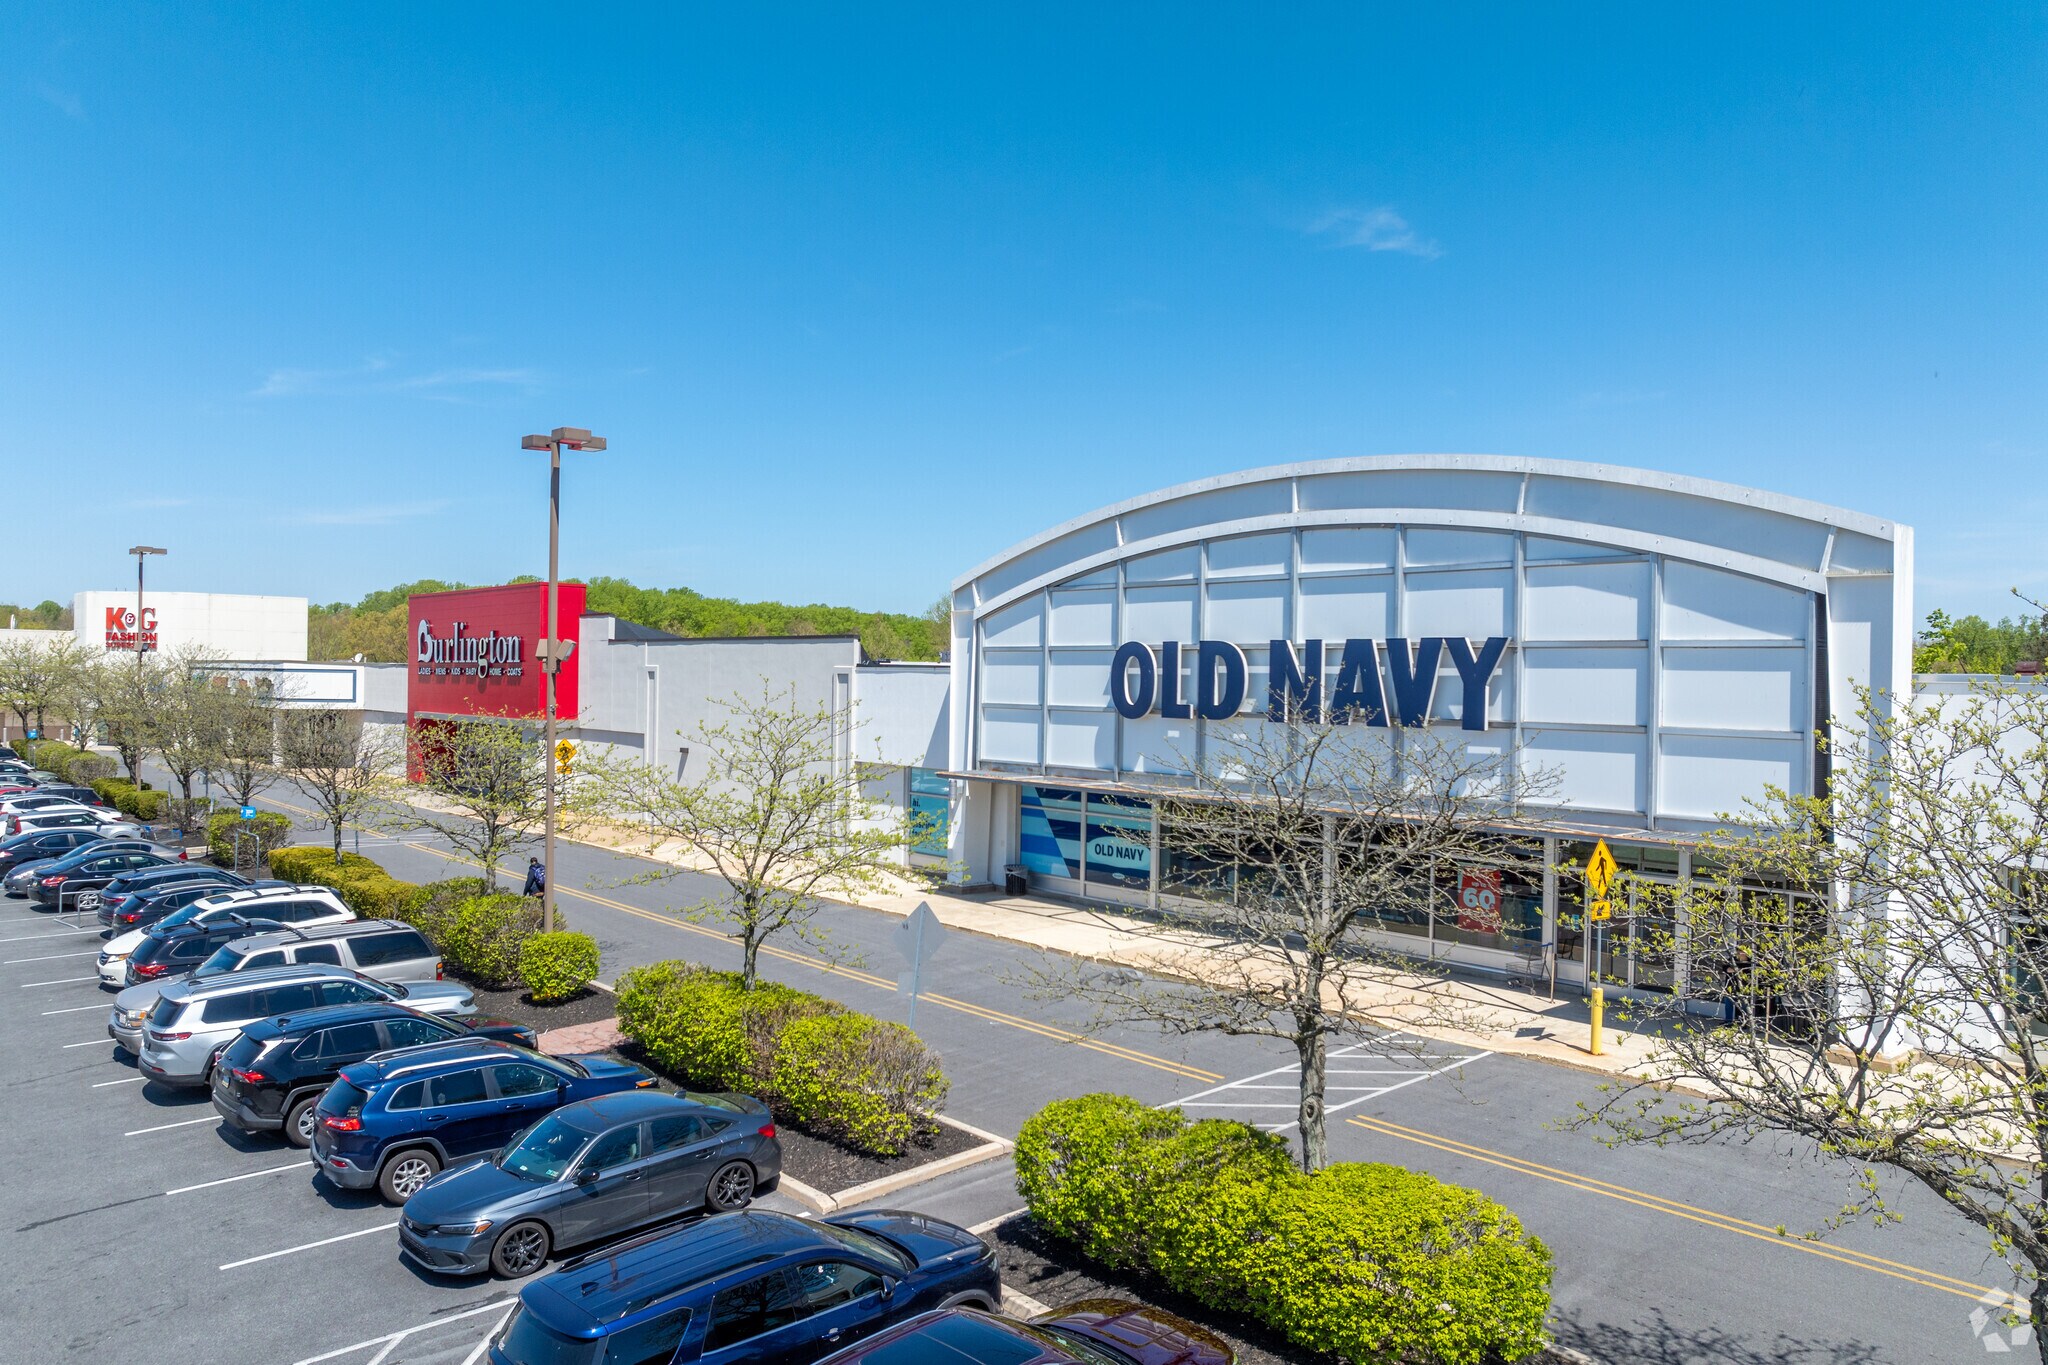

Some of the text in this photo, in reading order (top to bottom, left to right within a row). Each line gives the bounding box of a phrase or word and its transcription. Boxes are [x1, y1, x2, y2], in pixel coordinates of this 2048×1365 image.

[417, 619, 521, 678] Burlington
[451, 667, 461, 675] KIDS
[1110, 637, 1512, 731] OLD NAVY
[1095, 844, 1144, 861] OLD NAVY
[1463, 887, 1495, 910] 60
